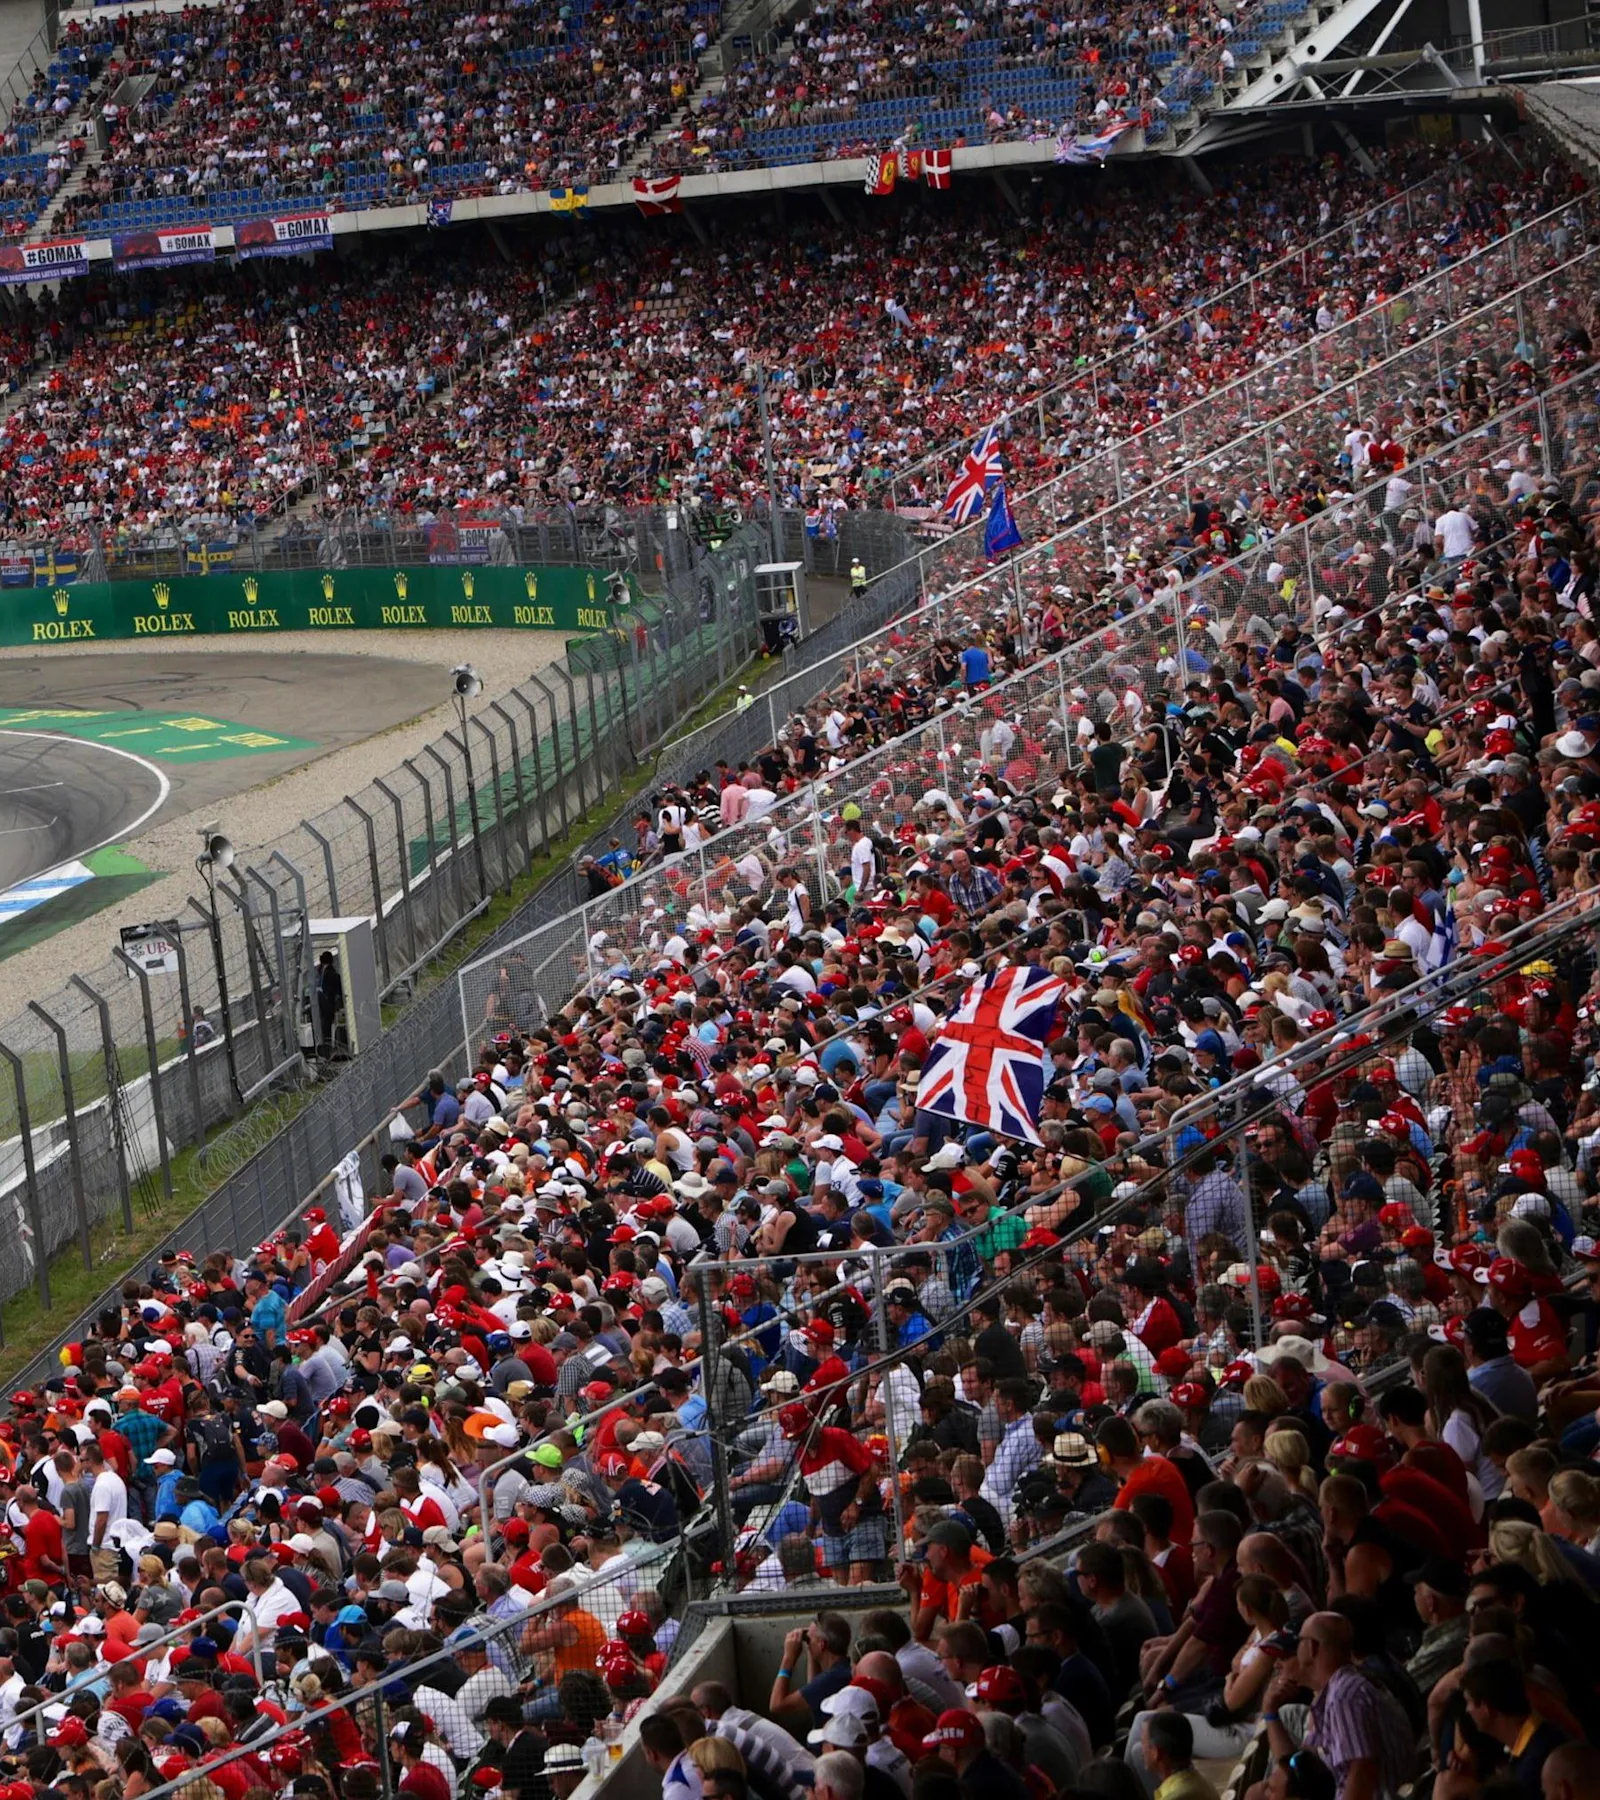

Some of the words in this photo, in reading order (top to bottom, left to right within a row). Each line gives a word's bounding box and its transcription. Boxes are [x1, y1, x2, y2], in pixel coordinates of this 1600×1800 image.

[277, 217, 330, 238] #GOMAX
[167, 233, 211, 250] #GOMAX
[27, 245, 83, 264] #GOMAX
[134, 614, 194, 632] ROLEX
[228, 610, 279, 627] ROLEX
[309, 608, 354, 624] ROLEX
[382, 606, 426, 623] ROLEX
[452, 606, 492, 623] ROLEX
[514, 606, 554, 624] ROLEX
[577, 608, 607, 628] ROLEX
[33, 620, 95, 640] ROLEX
